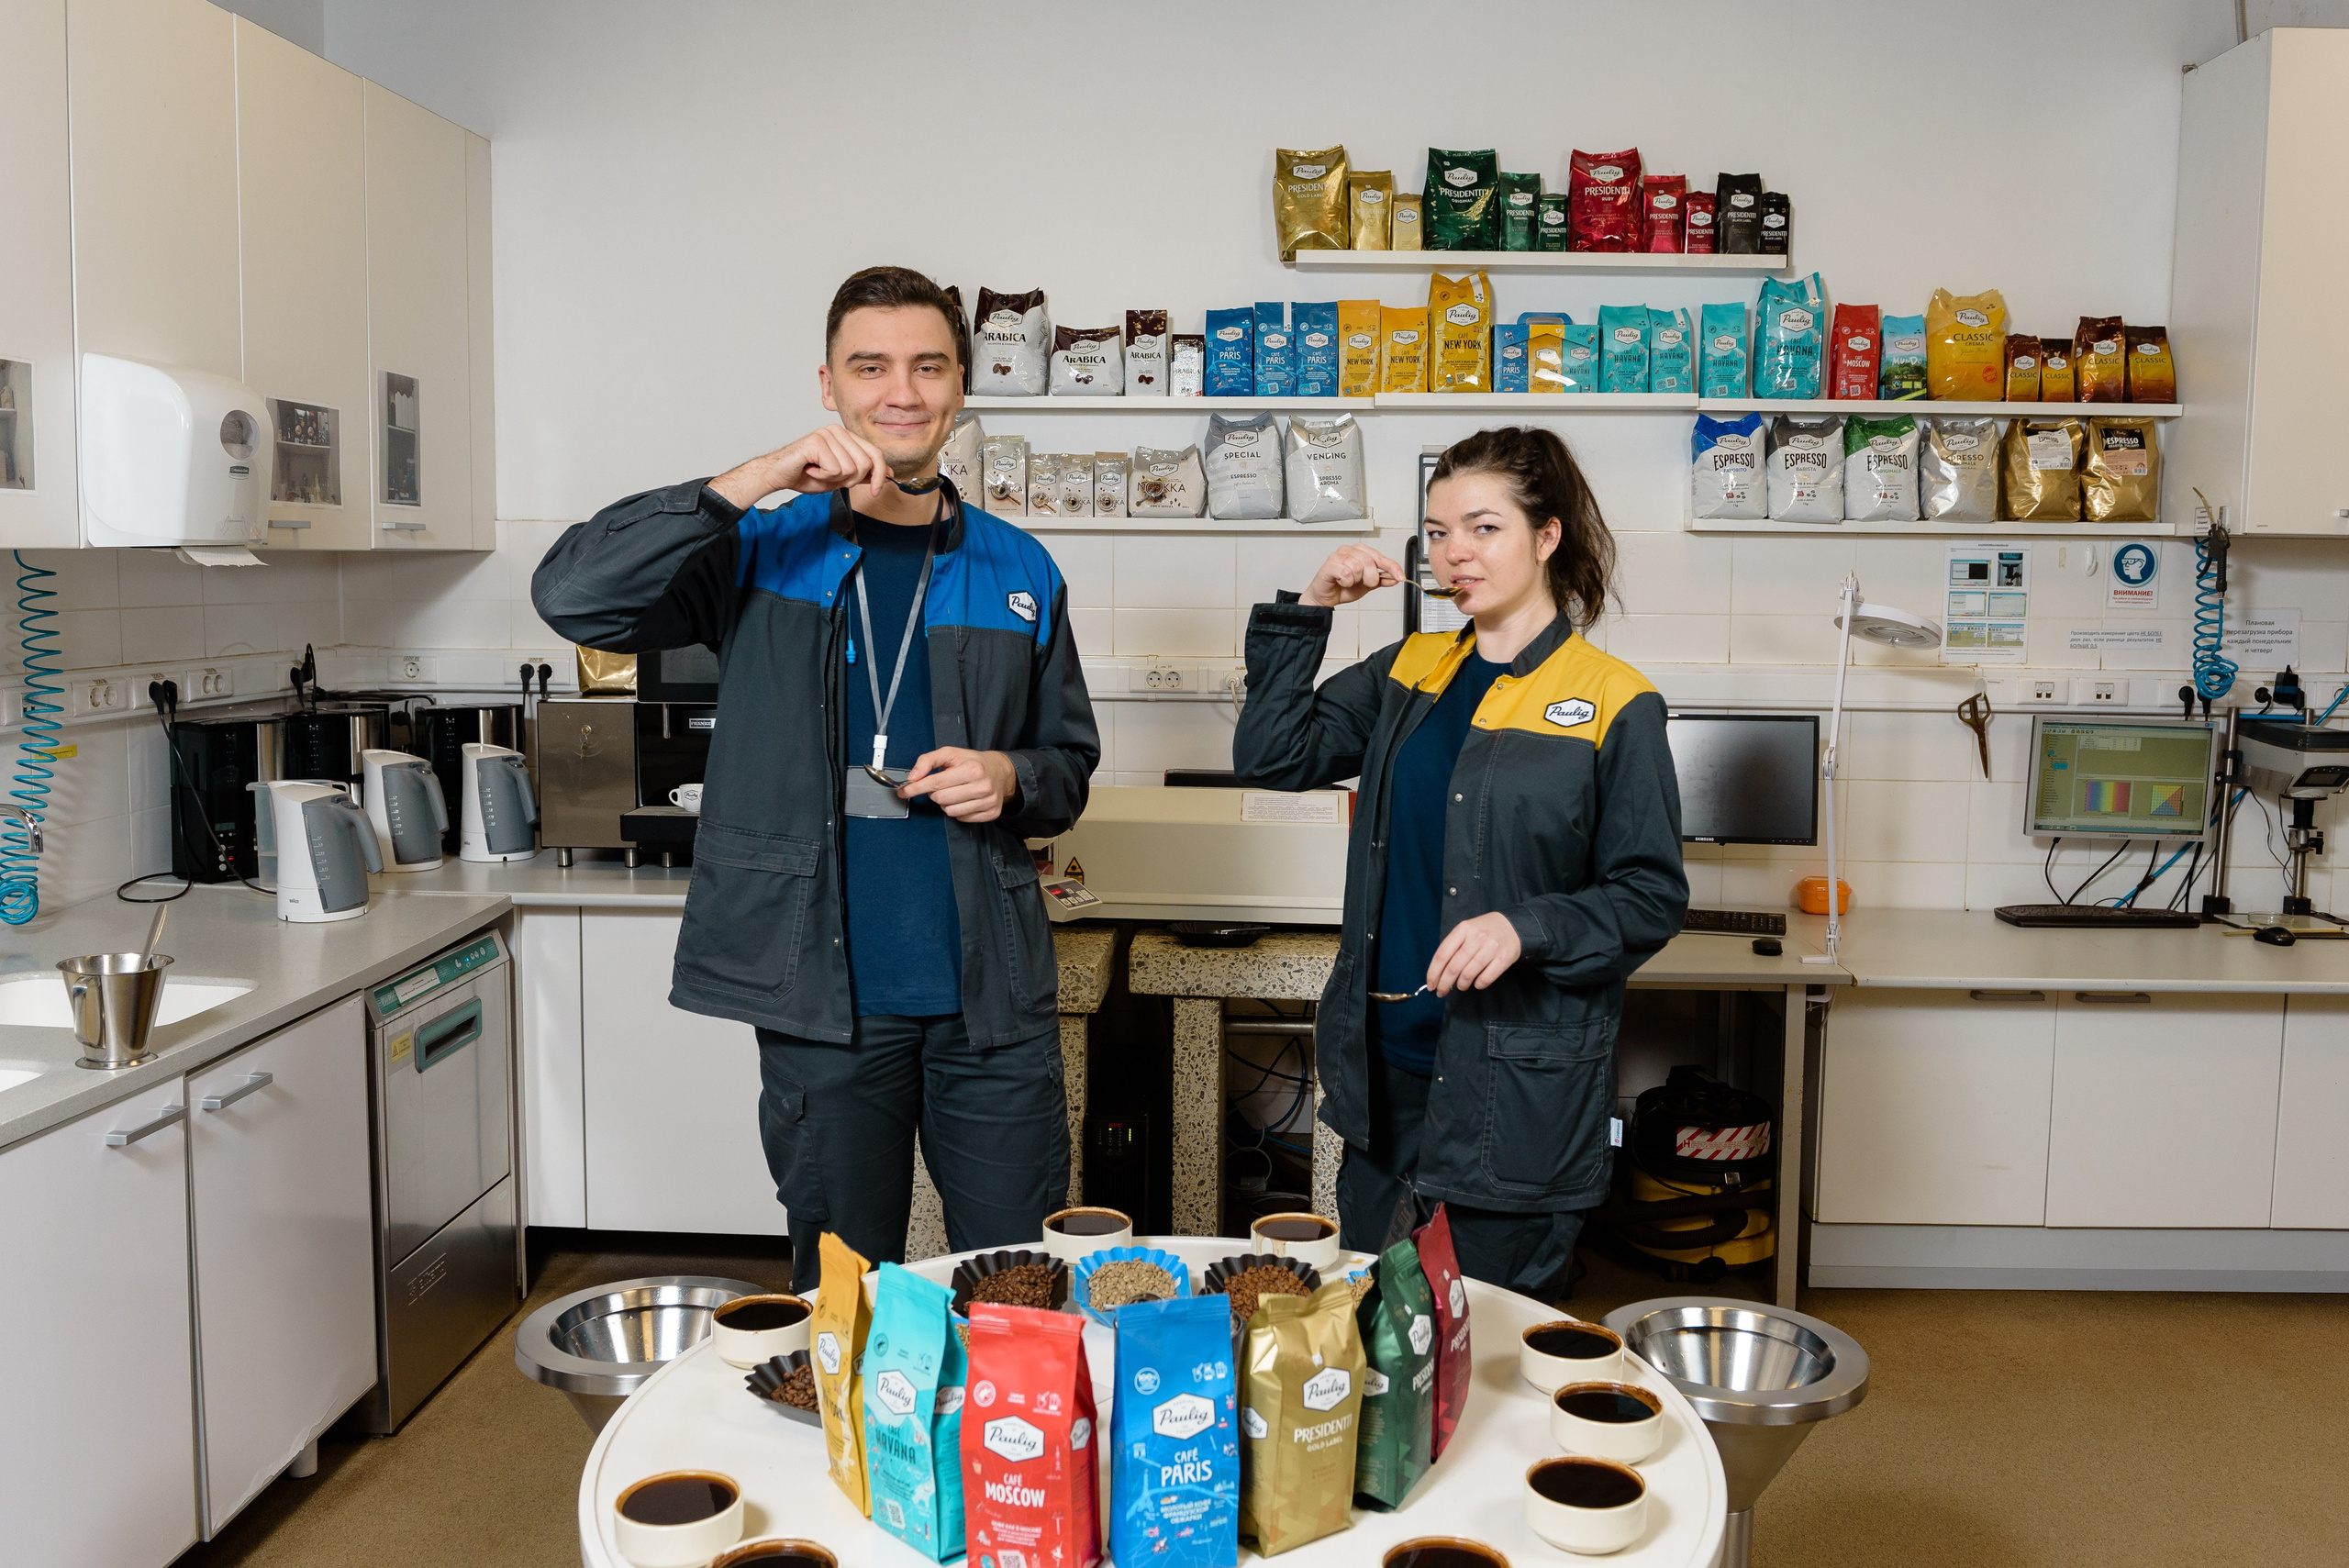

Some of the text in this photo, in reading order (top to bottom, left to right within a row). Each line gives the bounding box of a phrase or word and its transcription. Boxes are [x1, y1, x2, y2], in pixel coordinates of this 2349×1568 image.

[1296, 166, 1323, 176] Paulig
[1592, 168, 1621, 178] Paulig
[1447, 172, 1475, 183] Paulig
[1585, 186, 1631, 195] PRESIDENTTI
[1362, 192, 1382, 200] Paulig
[1732, 195, 1753, 204] Paulig
[1654, 197, 1675, 206] Paulig
[1398, 212, 1417, 220] Paulig
[1506, 209, 1535, 217] PRESIDENTTI
[1544, 213, 1564, 222] Paulig
[1727, 211, 1757, 219] PRESIDENTTI
[1692, 215, 1710, 224] Paulig
[1765, 217, 1783, 226] Paulig
[992, 312, 1020, 322] Paulig
[1448, 308, 1477, 320] Paulig
[1958, 312, 1987, 324] Paulig
[1782, 314, 1811, 326] Paulig
[1219, 329, 1241, 339] Paulig
[1394, 333, 1417, 341] Paulig
[1616, 331, 1639, 340] Paulig
[1661, 333, 1681, 341] Paulig
[1954, 333, 1993, 342] CLASSIC
[1135, 336, 1156, 346] Paulig
[1265, 336, 1286, 345] Paulig
[1307, 335, 1328, 345] Paulig
[1349, 337, 1370, 346] Paulig
[1444, 340, 1482, 350] NEW YORK
[1715, 339, 1736, 349] Paulig
[1849, 339, 1869, 349] Paulig
[1072, 341, 1098, 351] Paulig
[1776, 345, 1813, 357] HAVANA
[2096, 344, 2115, 352] Paulig
[2139, 345, 2158, 353] Paulig
[1063, 355, 1107, 365] ARABICA
[1130, 351, 1162, 360] ARABICA
[1219, 351, 1241, 360] PARIS
[1265, 356, 1286, 365] PARIS
[1307, 355, 1327, 364] PARIS
[1390, 355, 1420, 364] NEW YORK
[1614, 355, 1642, 363] HAVANA
[1660, 352, 1684, 361] HAVANA
[1359, 358, 1374, 366] YORK
[1713, 359, 1739, 367] HAVANA
[1846, 360, 1871, 368] MOSCOW
[2015, 359, 2034, 368] Paulig
[2049, 359, 2065, 368] Paulig
[2088, 357, 2120, 365] CLASSIC
[1503, 366, 1520, 374] PARIS
[2009, 371, 2037, 379] CLASSIC
[1228, 432, 1255, 443] Paulig
[1719, 437, 1747, 446] Paulig
[1792, 436, 1820, 446] Paulig
[1870, 438, 1899, 447] Paulig
[1946, 437, 1976, 447] Paulig
[2107, 436, 2139, 445] ESPRESSO
[1224, 451, 1261, 461] SPECIAL
[1307, 452, 1347, 461] VENDING
[1785, 451, 1827, 471] ESPRESSO
[996, 461, 1014, 469] Paulig
[1713, 452, 1755, 472] ESPRESSO
[1866, 452, 1909, 473] ESPRESSO
[1151, 463, 1177, 474] Paulig
[1037, 474, 1054, 484] Paulig
[1067, 473, 1086, 483] Paulig
[1102, 474, 1120, 484] Paulig
[1012, 595, 1035, 617] Paulig
[1549, 706, 1590, 719] Paulig
[818, 1339, 839, 1368] Paulig
[880, 1378, 912, 1407] Paulig
[1308, 1379, 1345, 1401] Paulig
[1160, 1406, 1208, 1426] Paulig
[1294, 1414, 1353, 1443] PRESIDENTTI
[990, 1426, 1038, 1451] Paulig
[875, 1429, 917, 1464] HAVANA
[1307, 1436, 1343, 1452] GOLD LABEL
[1174, 1447, 1198, 1463] CAFÉ
[1161, 1460, 1213, 1487] PARIS
[1003, 1473, 1022, 1486] CAFÉ
[985, 1480, 1045, 1508] MOSCOW
